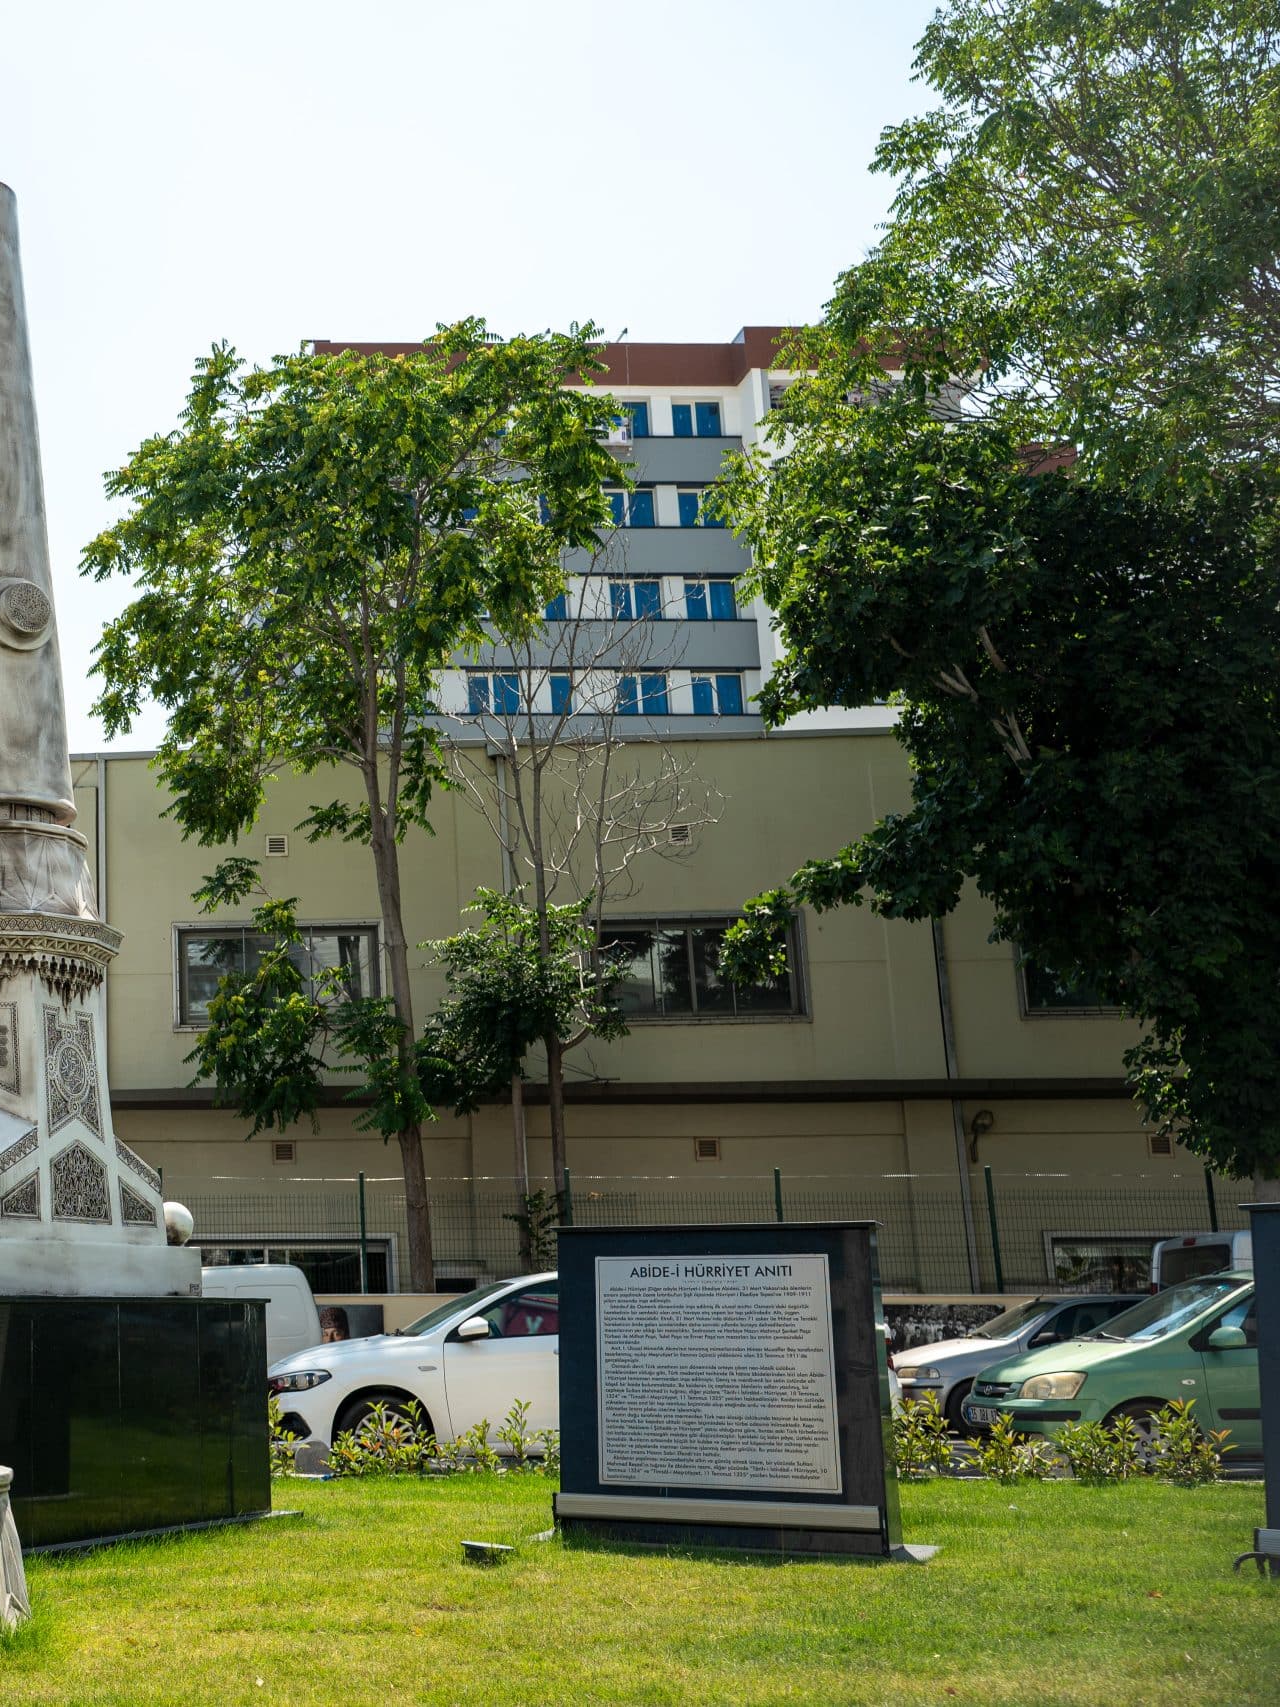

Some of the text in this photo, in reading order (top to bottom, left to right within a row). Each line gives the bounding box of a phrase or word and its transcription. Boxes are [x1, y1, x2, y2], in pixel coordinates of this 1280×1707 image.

[630, 1263, 792, 1278] ABİDE-İ HÜRRİYET ANITI
